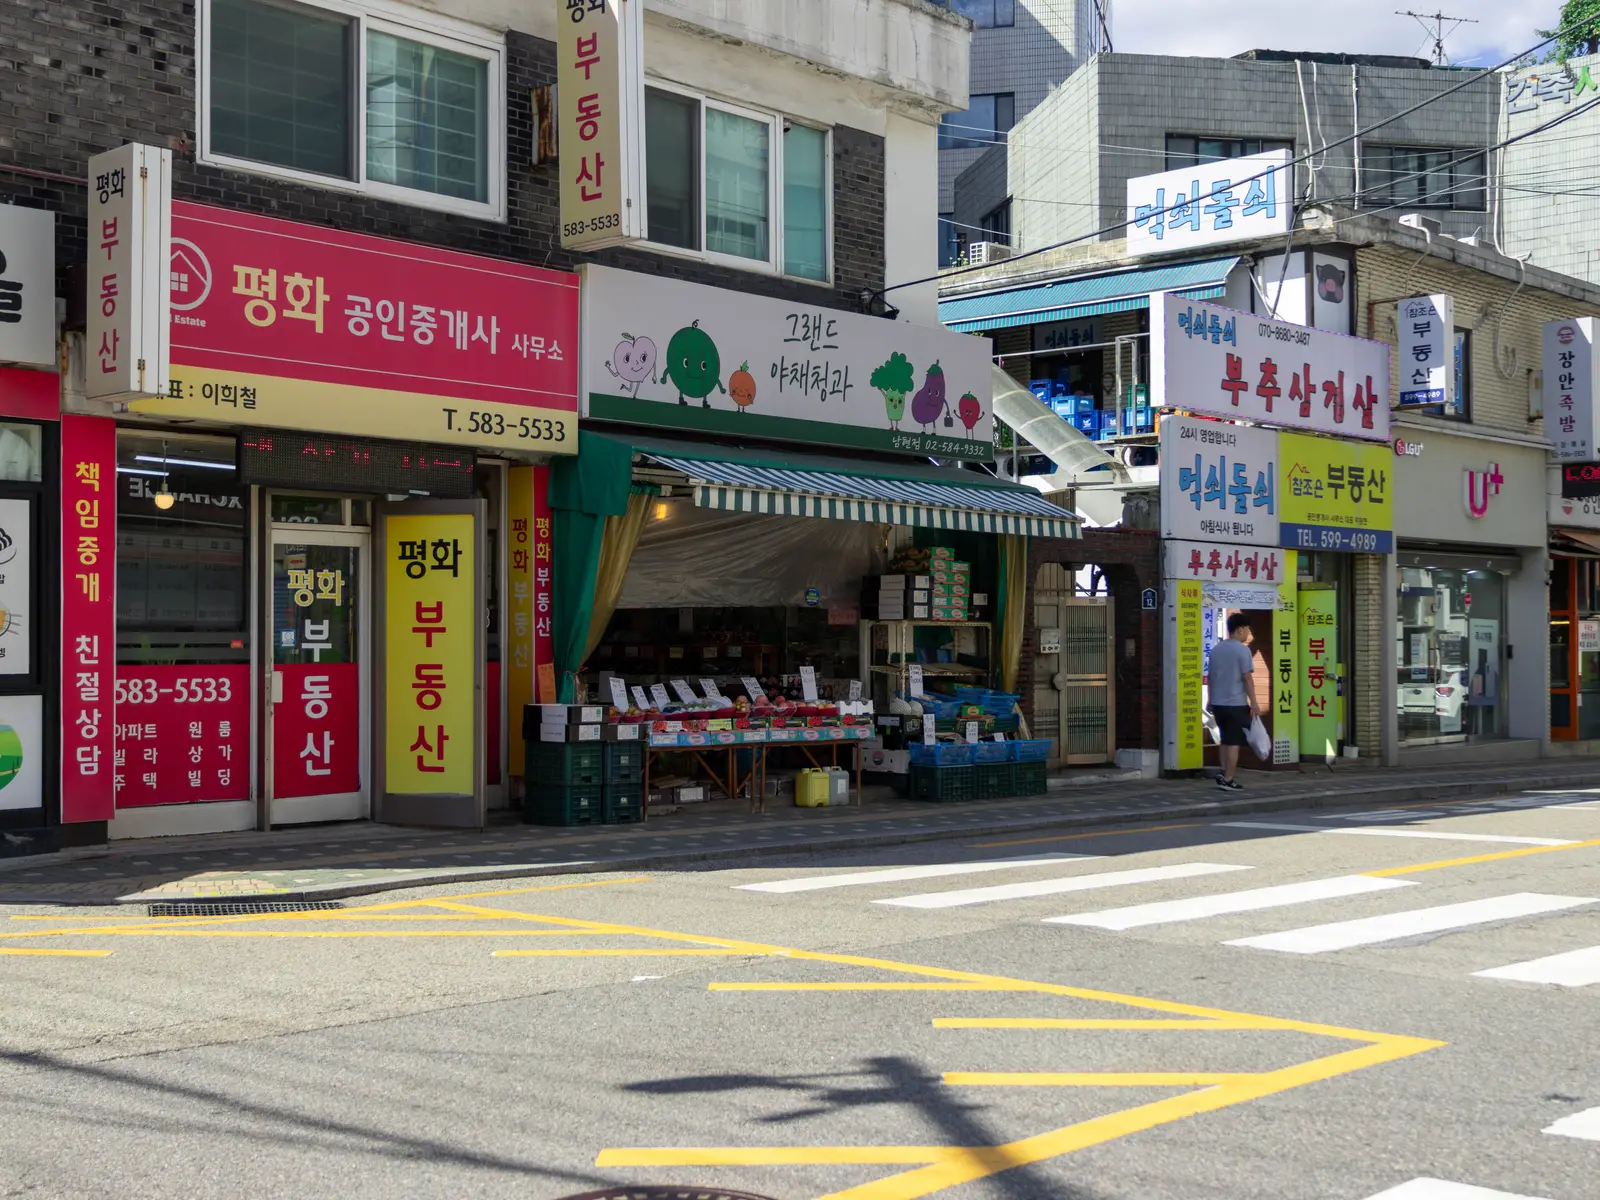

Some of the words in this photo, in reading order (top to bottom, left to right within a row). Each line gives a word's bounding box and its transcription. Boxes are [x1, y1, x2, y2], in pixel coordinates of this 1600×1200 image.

[574, 32, 605, 202] 부동산
[96, 167, 126, 205] 평화
[563, 213, 620, 237] 583-5533
[98, 216, 120, 374] 부동산
[232, 264, 331, 334] 평화
[344, 294, 501, 355] 공인중개사
[511, 333, 564, 362] 사무소
[1409, 305, 1437, 318] 참조은
[174, 314, 207, 328] Estate
[784, 313, 839, 352] 그랜드
[1258, 323, 1311, 346] 070-8680-3487
[1411, 321, 1433, 386] 부동산
[202, 383, 257, 410] 이희철
[771, 355, 854, 402] 야채청과
[1220, 352, 1378, 430] 부추삼겹살
[1558, 351, 1575, 433] 장안족발
[891, 436, 921, 451] 남현점
[925, 440, 985, 457] 02-584-9332
[1180, 426, 1198, 442] 24시
[1200, 429, 1237, 447] 영업합니다
[1292, 476, 1324, 499] 참조은
[1327, 463, 1386, 504] 부동산
[75, 461, 100, 603] 책임중개
[512, 517, 529, 574] 평화
[536, 517, 551, 563] 평화
[1200, 520, 1231, 536] 아침식사
[1232, 523, 1254, 537] 됩니다
[1320, 531, 1377, 550] 599-4989
[398, 538, 463, 580] 평화
[1187, 549, 1278, 580] 부추삼겹살
[287, 569, 346, 607] 평화
[536, 568, 551, 637] 부동산
[513, 581, 529, 668] 부동산
[1306, 613, 1334, 625] 참조은
[115, 678, 232, 704] 583-5533
[410, 601, 450, 773] 부동산
[1278, 629, 1293, 714] 부동산
[1307, 637, 1327, 718] 부동산
[75, 635, 102, 776] 친절상담
[300, 618, 335, 776] 부동산
[115, 723, 158, 741] 아파트
